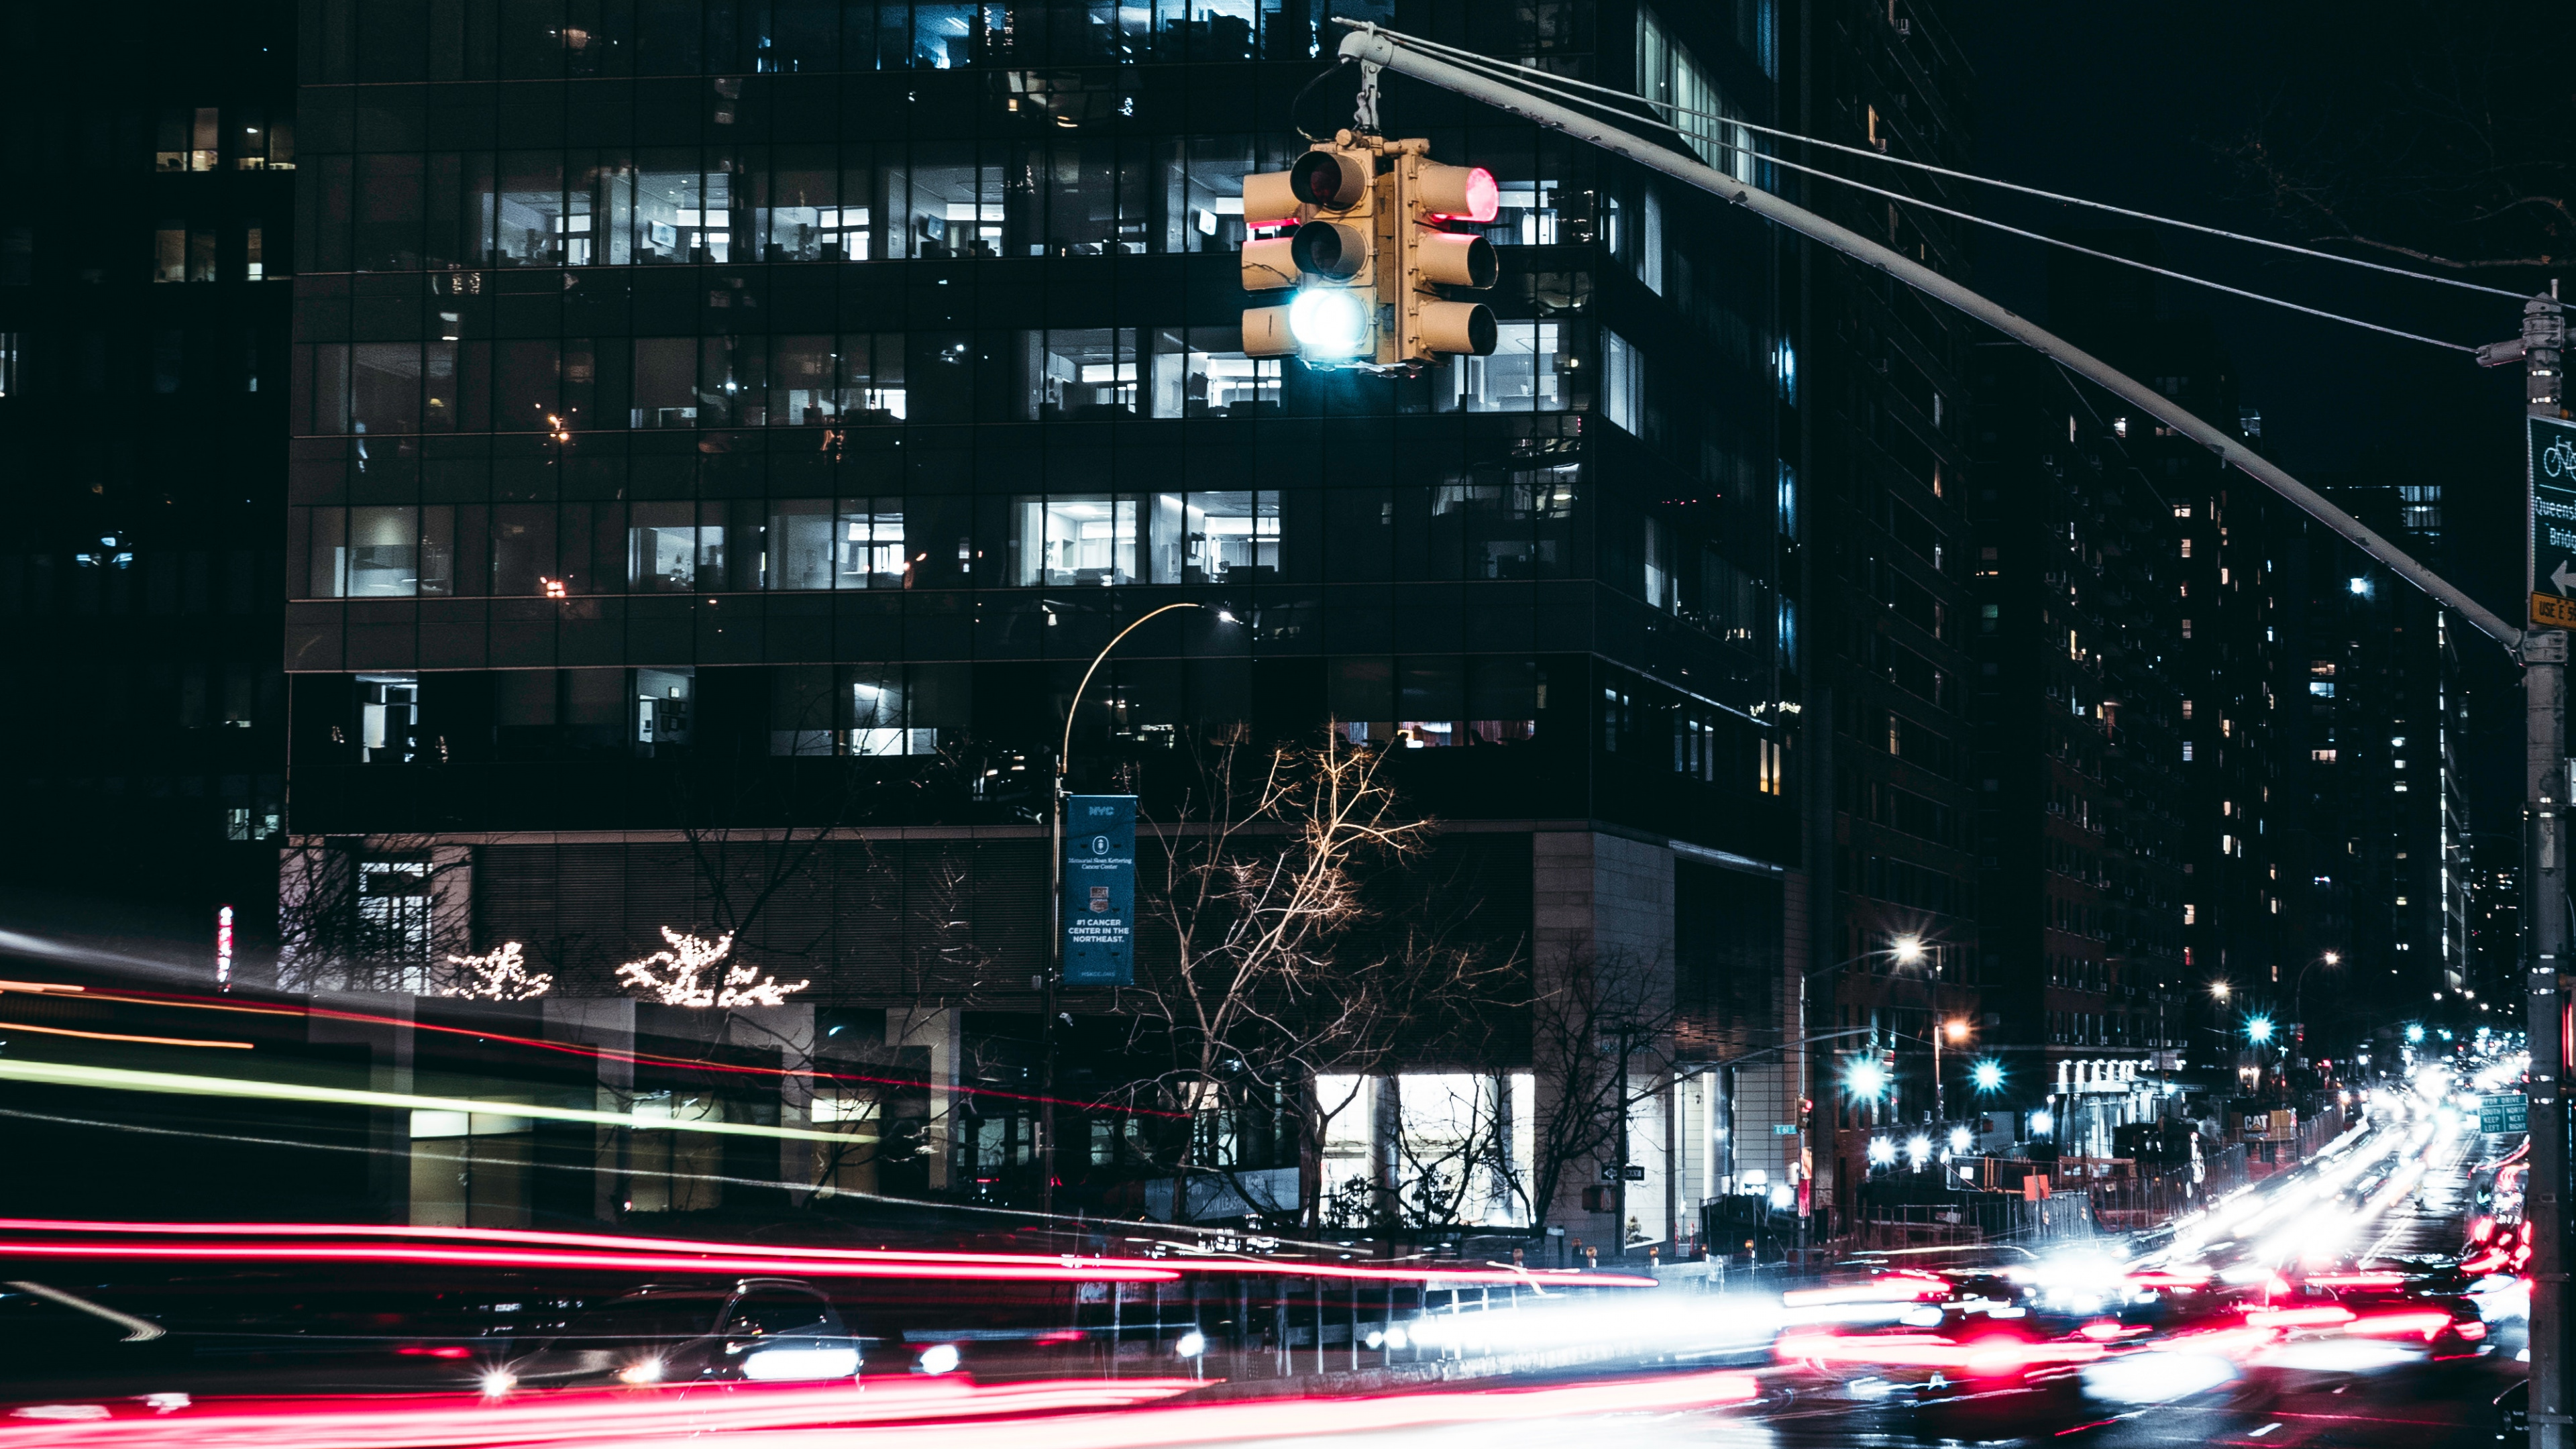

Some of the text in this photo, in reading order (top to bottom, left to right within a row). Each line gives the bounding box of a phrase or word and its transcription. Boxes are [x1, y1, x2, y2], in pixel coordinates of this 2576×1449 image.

[2535, 496, 2576, 521] Queens
[2550, 527, 2576, 554] Bridg
[2539, 600, 2555, 618] USE
[2559, 604, 2564, 620] E
[1089, 806, 1114, 816] NYC
[2500, 1096, 2520, 1104] DRIVE
[2481, 1108, 2502, 1116] SOUTH
[2506, 1106, 2526, 1114] NORTH
[2244, 1115, 2268, 1131] CAT
[2483, 1116, 2500, 1124] KEEP
[2484, 1124, 2500, 1132] LEFT
[2508, 1122, 2526, 1130] RIGHT
